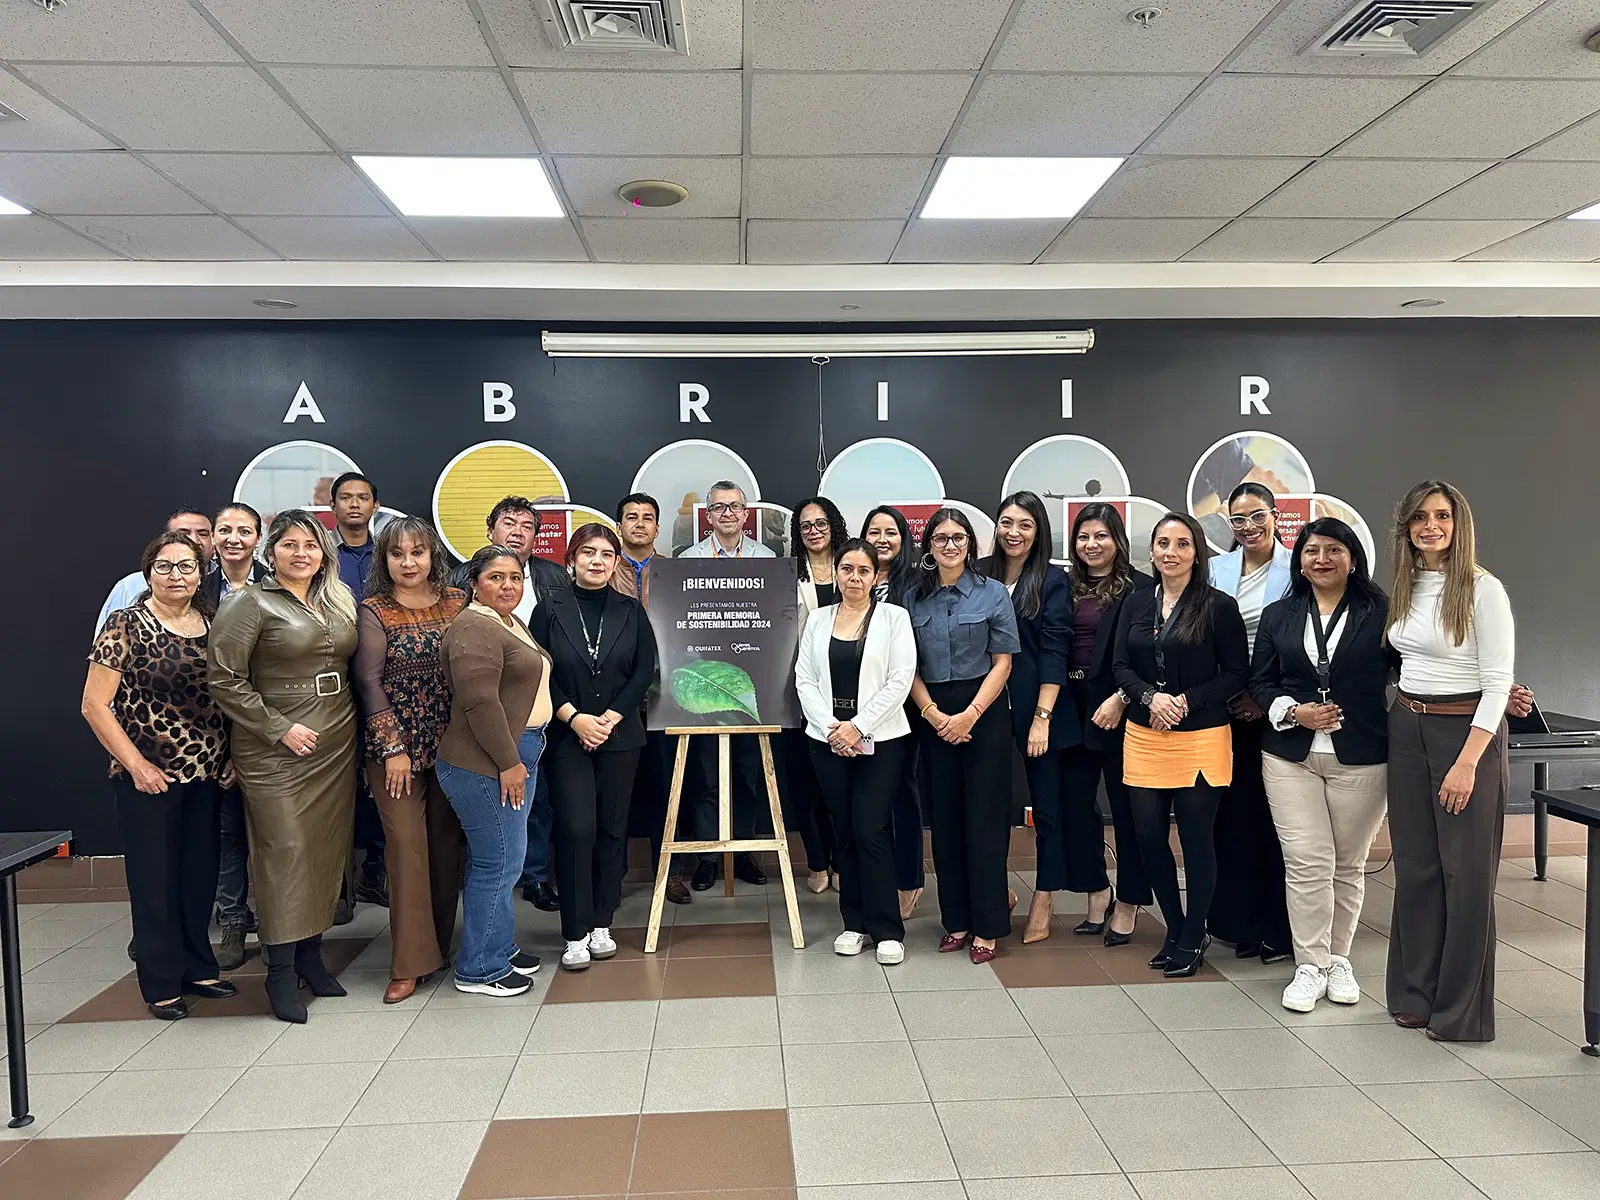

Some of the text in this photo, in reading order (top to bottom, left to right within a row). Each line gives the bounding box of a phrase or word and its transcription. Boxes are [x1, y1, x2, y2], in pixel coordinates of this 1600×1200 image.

[282, 375, 1272, 423] A B R I I R
[682, 577, 765, 592] ¡BIENVENIDOS!
[687, 611, 761, 620] PRIMERA MEMORIA
[676, 620, 771, 629] DE SOSTENIBILIDAD 2024
